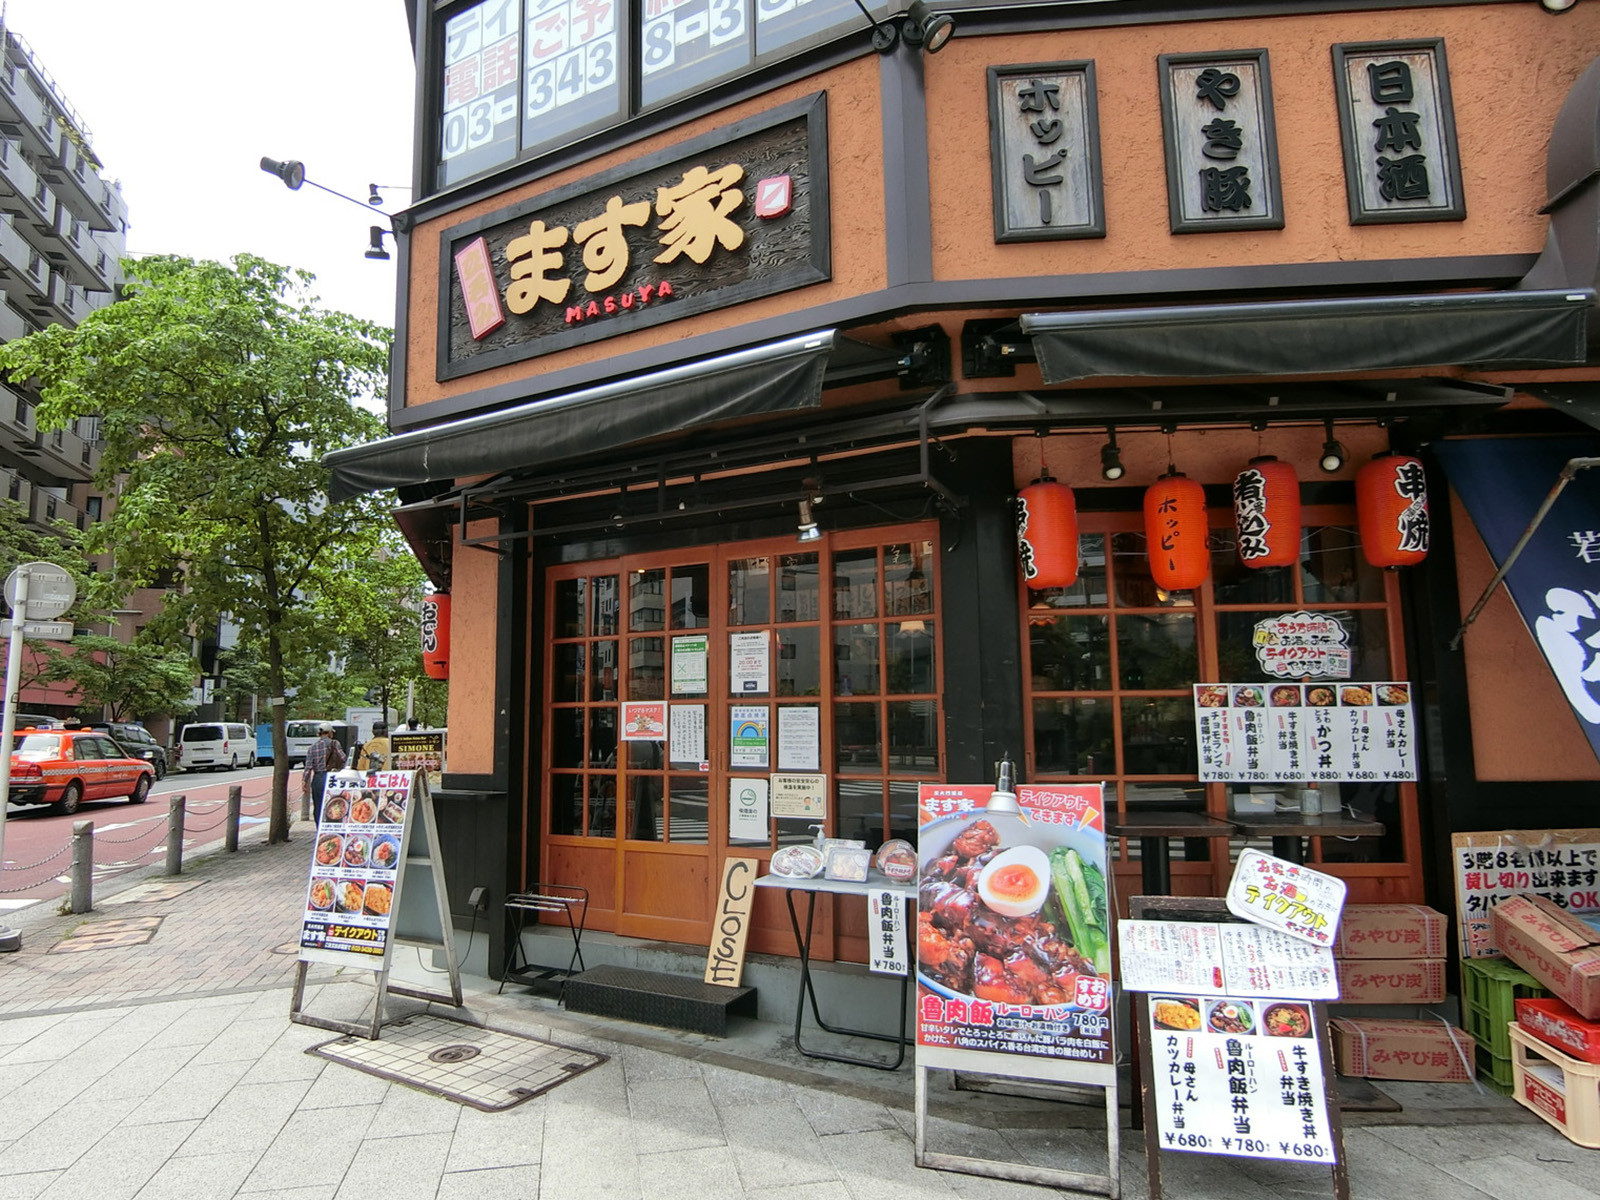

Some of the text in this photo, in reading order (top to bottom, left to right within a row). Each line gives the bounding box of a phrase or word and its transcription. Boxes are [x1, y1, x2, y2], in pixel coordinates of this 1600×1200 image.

[447, 36, 517, 105] 電話
[1196, 69, 1252, 212] やき豚
[1366, 61, 1431, 202] 日本酒
[1017, 80, 1067, 224] ホッピー
[505, 163, 745, 314] ます家
[564, 281, 674, 323] MASUYA
[1158, 497, 1180, 571] ホッピー
[422, 601, 438, 653] おでん
[1266, 647, 1326, 660] テイクアウト
[1245, 710, 1258, 770] 魯肉飯弁当
[1278, 731, 1287, 750] 弁当
[1288, 711, 1299, 769] 牛すき焼き丼
[1317, 725, 1332, 768] かつ丼
[1349, 709, 1360, 769] カツカレー弁当
[1361, 726, 1369, 752] 母さん
[1386, 729, 1395, 748] 弁当
[1396, 709, 1407, 768] 母さんカレー
[1203, 771, 1230, 780] ¥780
[1239, 771, 1266, 780] ¥780
[1275, 771, 1302, 780] ¥680
[1311, 771, 1338, 780] ¥880
[1347, 771, 1374, 780] ¥680
[1383, 771, 1411, 779] ¥480
[925, 797, 975, 812] ます家
[1020, 789, 1089, 810] テイクアウト
[1031, 808, 1076, 825] できます
[1465, 869, 1599, 890] 貸し切り出来ます
[710, 861, 748, 982] CLOSE
[1245, 885, 1328, 930] テイクアウト
[334, 926, 377, 940] テイクアウト
[881, 892, 894, 958] 魯肉飯弁当
[1349, 929, 1421, 943] みやび炭
[874, 959, 901, 971] ¥780
[1077, 978, 1106, 1008] おすすめ
[1351, 974, 1422, 988] みやび炭
[922, 995, 1070, 1026] 魯肉飯 ルーローハン
[1073, 1013, 1109, 1029] 780円
[1245, 1043, 1258, 1093] ルーローハン
[1372, 1049, 1449, 1067] みやび炭
[1166, 1035, 1185, 1129] カツカレー弁当
[1183, 1062, 1198, 1102] 母さん
[1226, 1038, 1250, 1134] 魯肉飯弁当
[1280, 1075, 1296, 1106] 弁当
[1292, 1045, 1317, 1139] 牛すき焼き丼
[1165, 1132, 1207, 1148] ¥680
[1221, 1137, 1265, 1153] ¥780
[1279, 1142, 1324, 1158] ¥680
